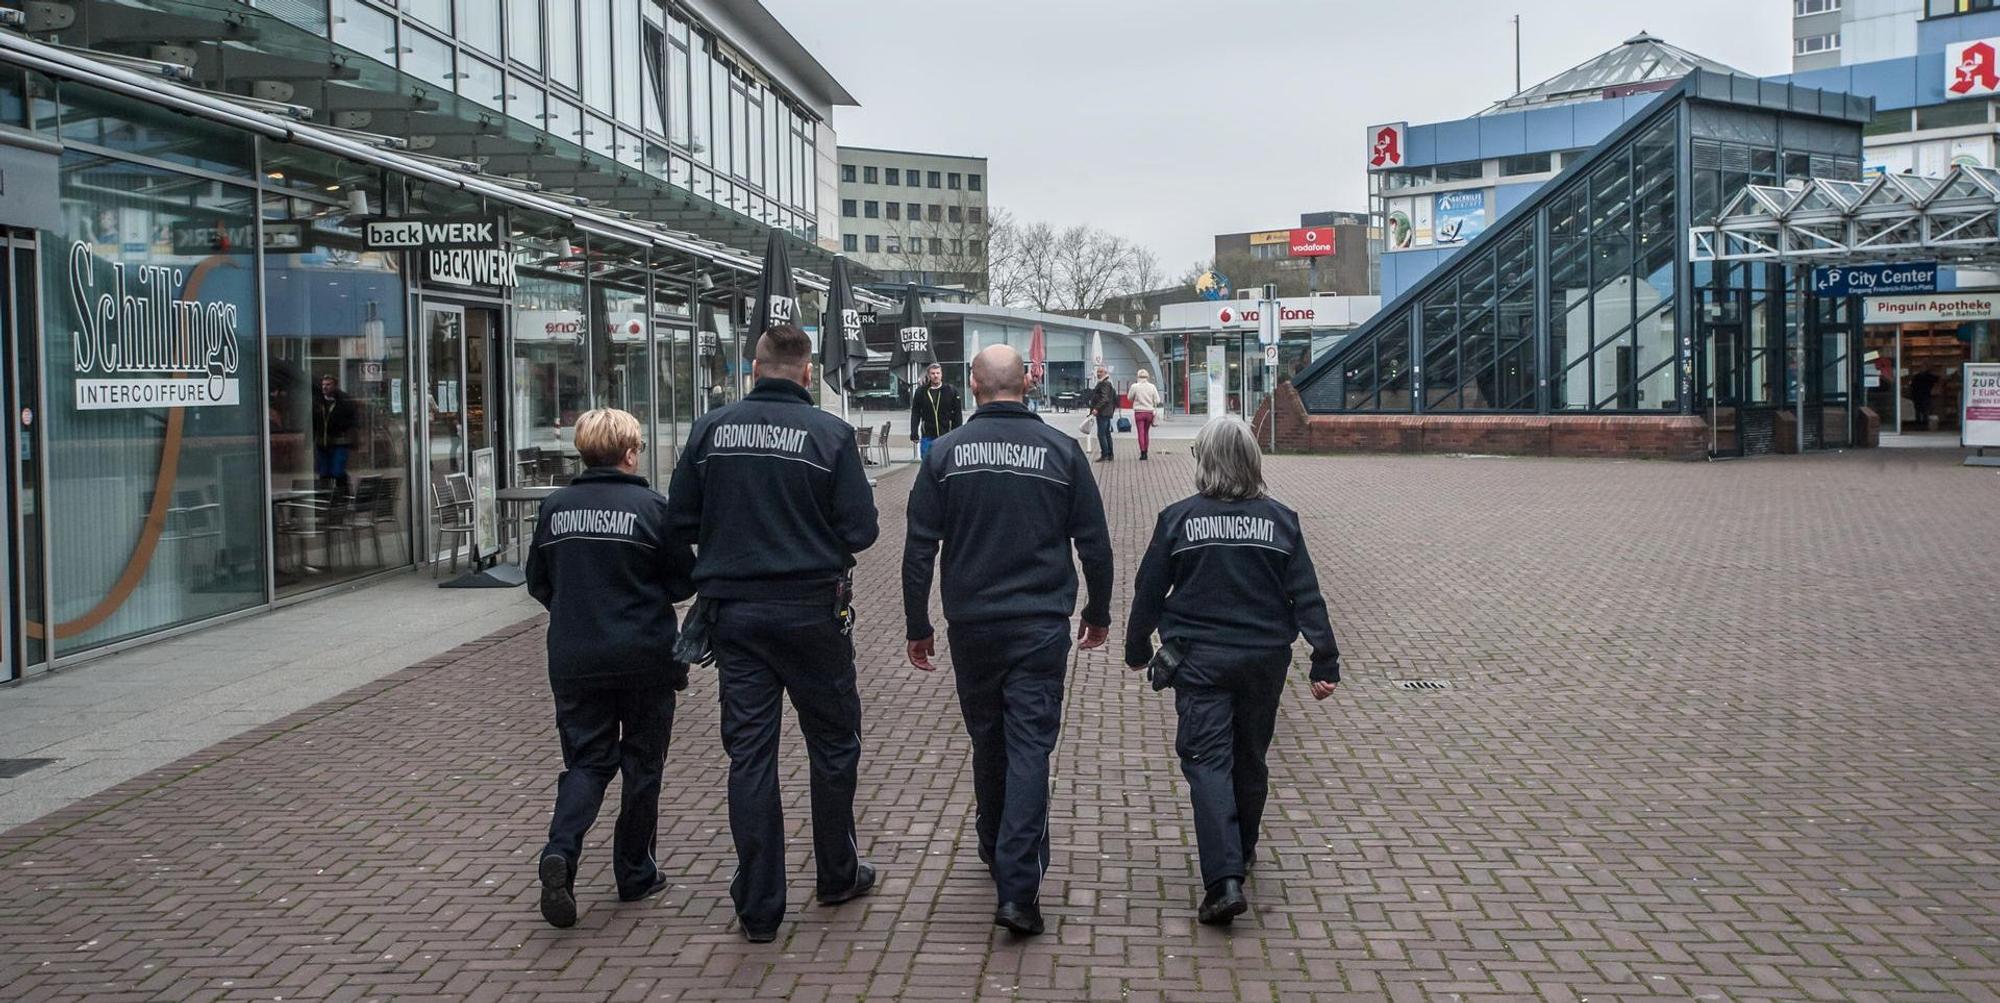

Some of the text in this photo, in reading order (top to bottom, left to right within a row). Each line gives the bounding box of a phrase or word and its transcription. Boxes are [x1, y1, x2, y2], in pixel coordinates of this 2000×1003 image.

[371, 222, 493, 244] backWERK
[1292, 242, 1331, 252] vodafone
[1848, 270, 1935, 288] City Center
[1241, 306, 1315, 321] vofone
[1878, 299, 1992, 314] Pinguin Apotheke
[902, 328, 926, 341] back
[81, 384, 205, 404] INTERCOIFFURE
[713, 424, 808, 453] ORDNUNGSAMT
[954, 442, 1048, 470] ORDNUNGSAMT
[551, 509, 638, 536] ORDNUNGSAMT
[1185, 515, 1275, 542] ORDNUNGSAMT
